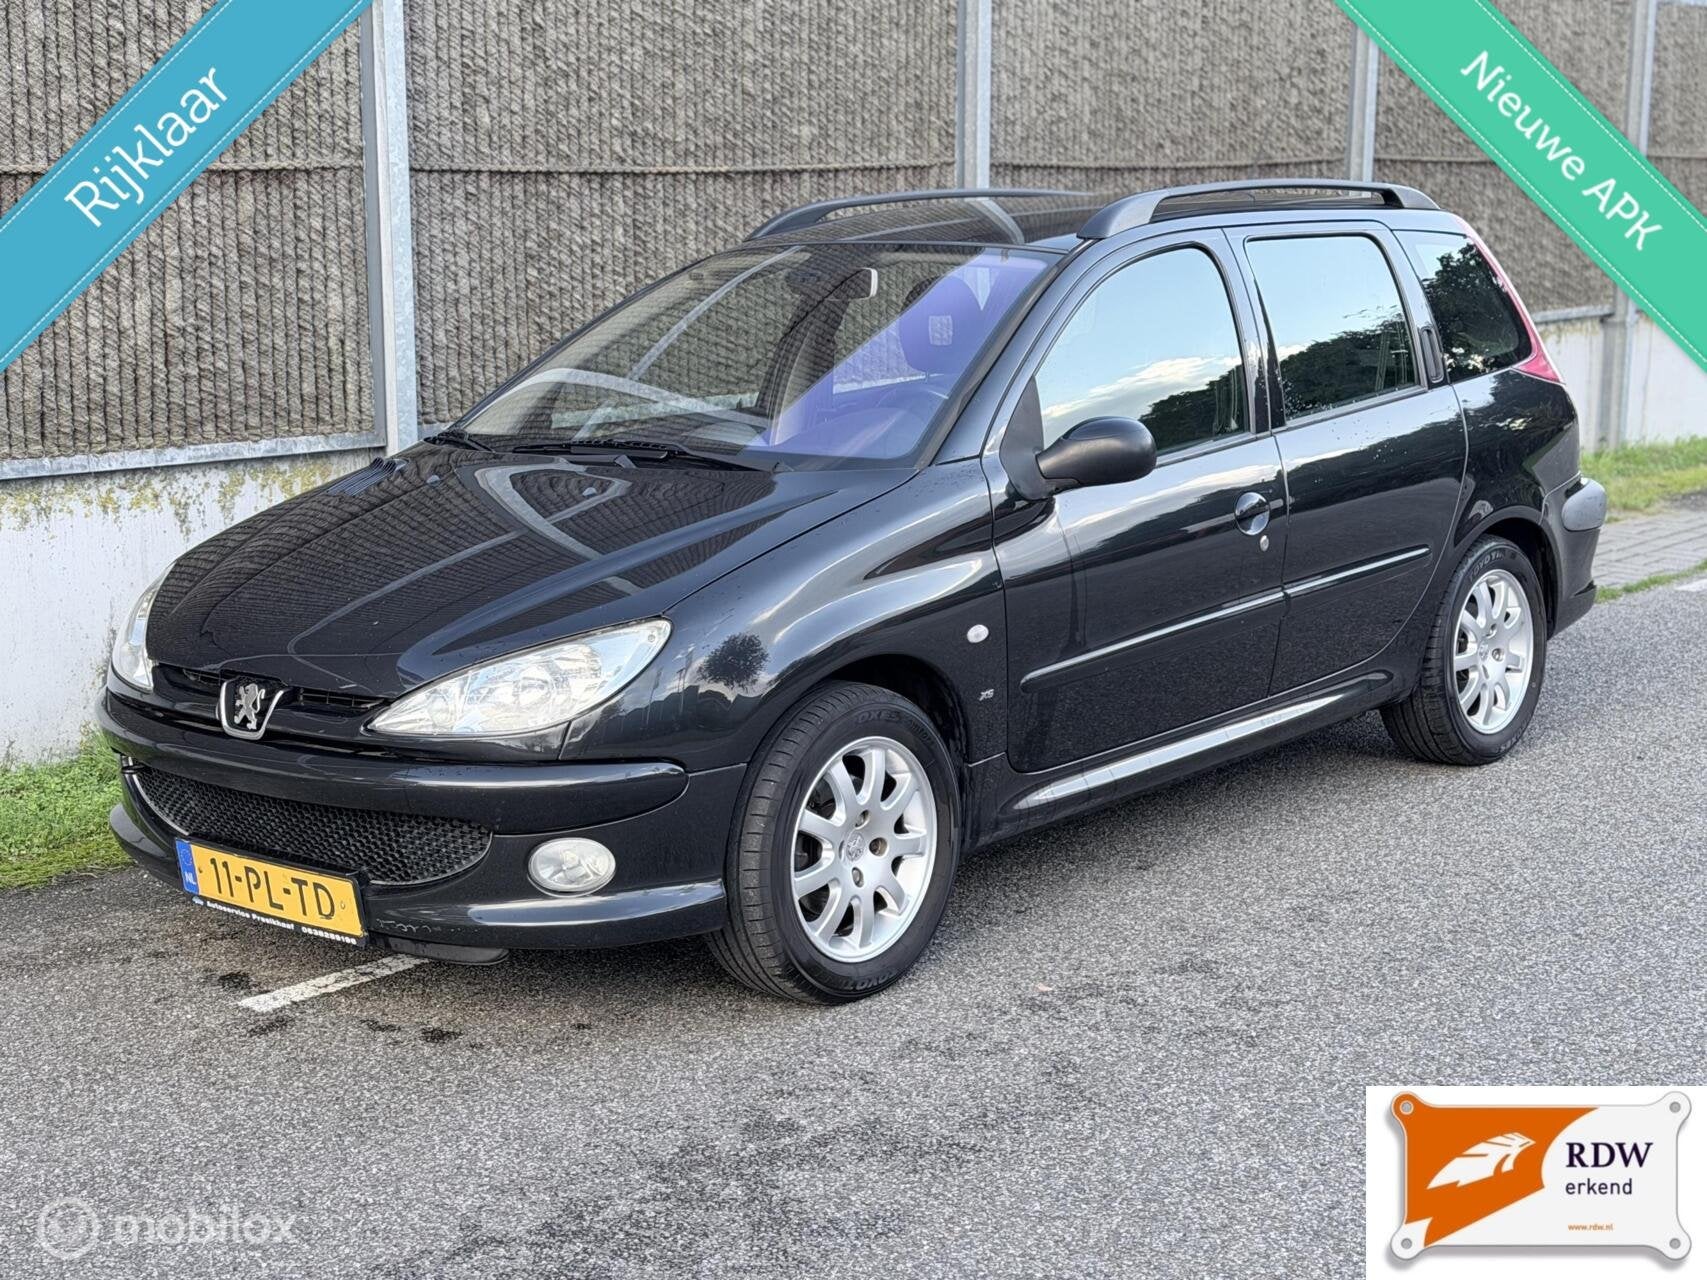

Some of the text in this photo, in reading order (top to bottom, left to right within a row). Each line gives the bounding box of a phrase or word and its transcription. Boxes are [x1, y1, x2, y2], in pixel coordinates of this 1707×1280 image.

[184, 871, 197, 886] NL
[210, 857, 336, 918] 11-PL-TD
[206, 900, 251, 919] Autoservice
